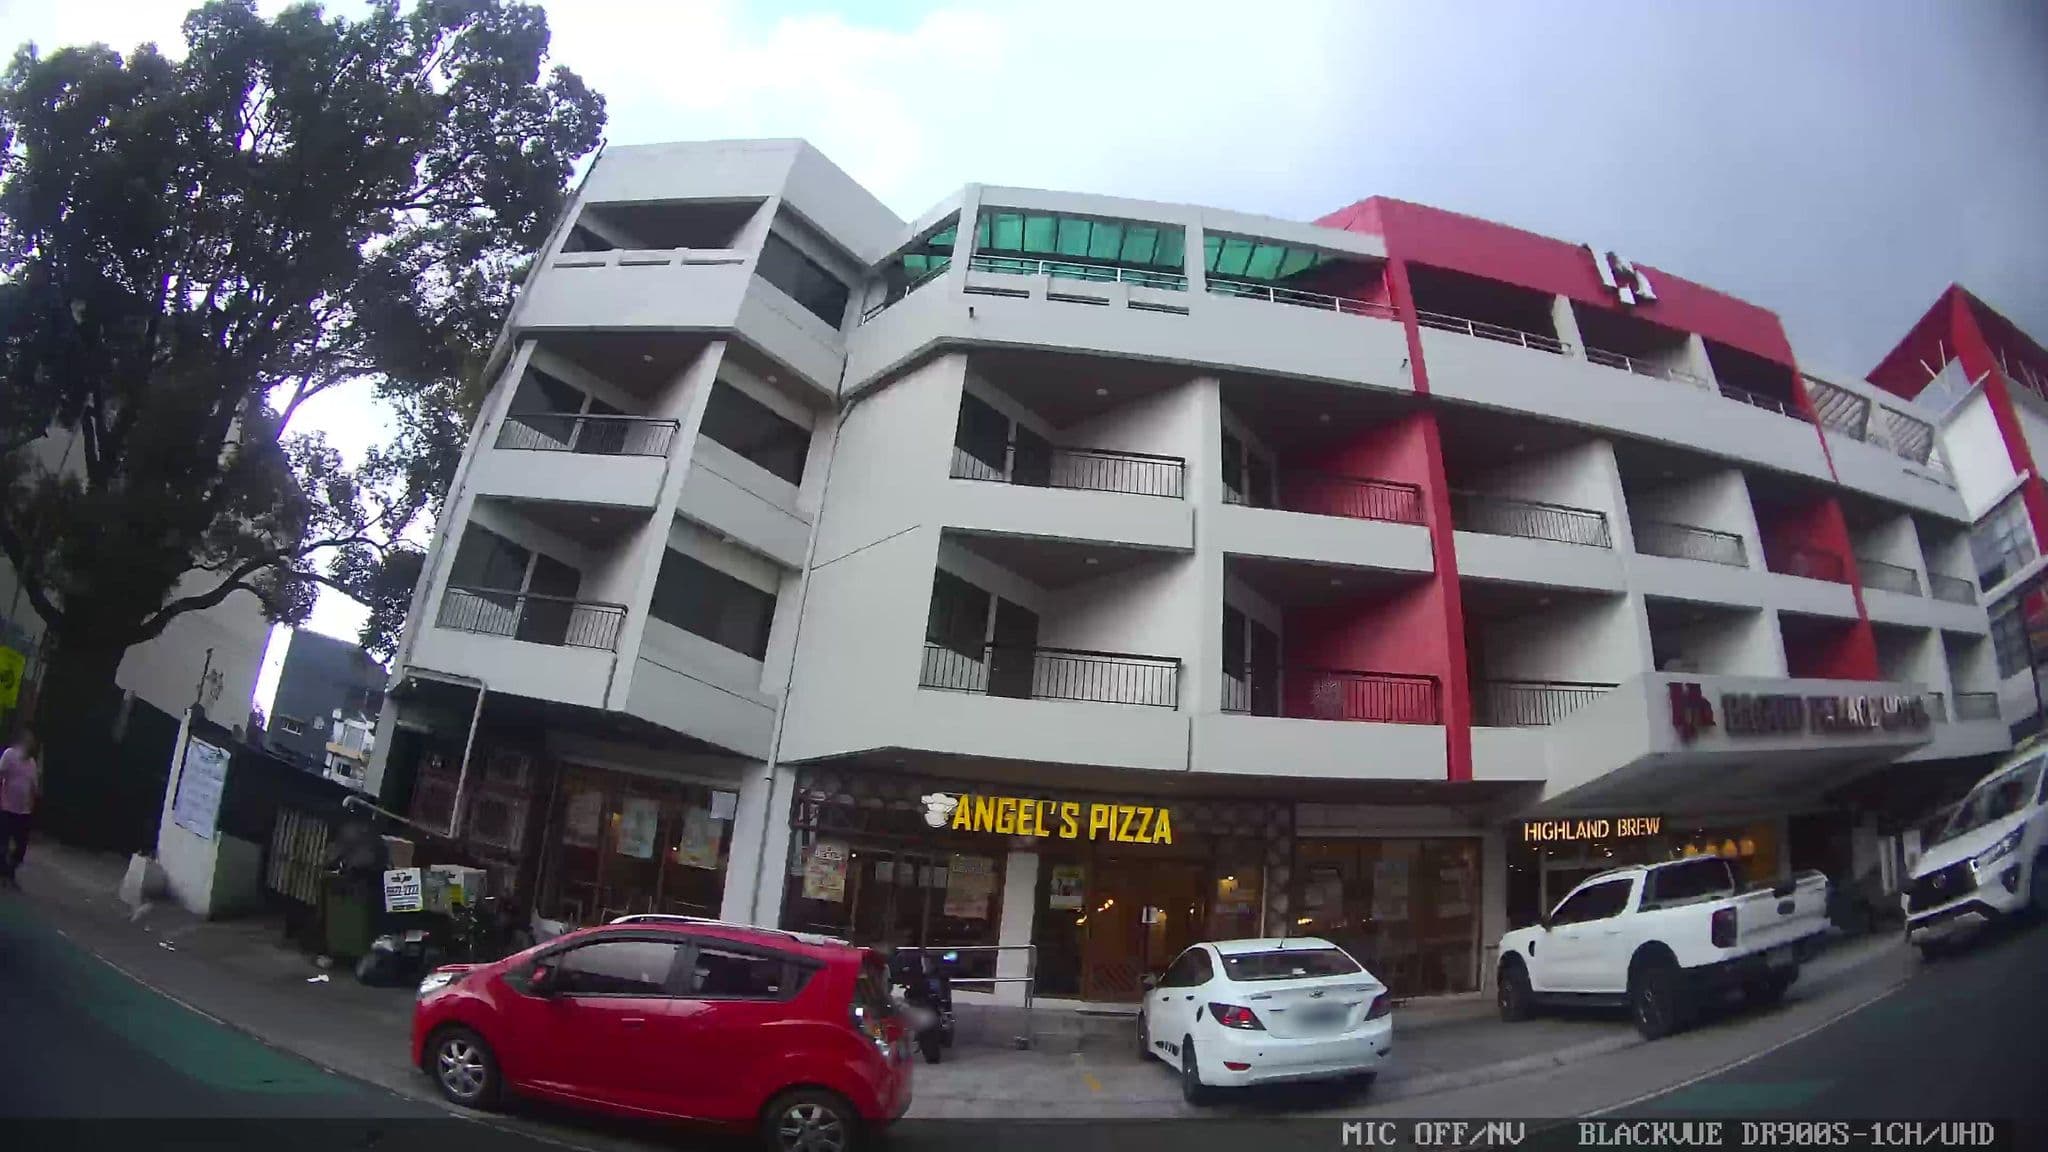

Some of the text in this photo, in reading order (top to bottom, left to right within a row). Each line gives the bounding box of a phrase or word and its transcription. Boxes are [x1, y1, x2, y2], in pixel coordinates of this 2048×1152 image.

[952, 794, 1172, 845] ANGEL'S PIZZA
[1524, 817, 1661, 841] HIGHLAND BREW
